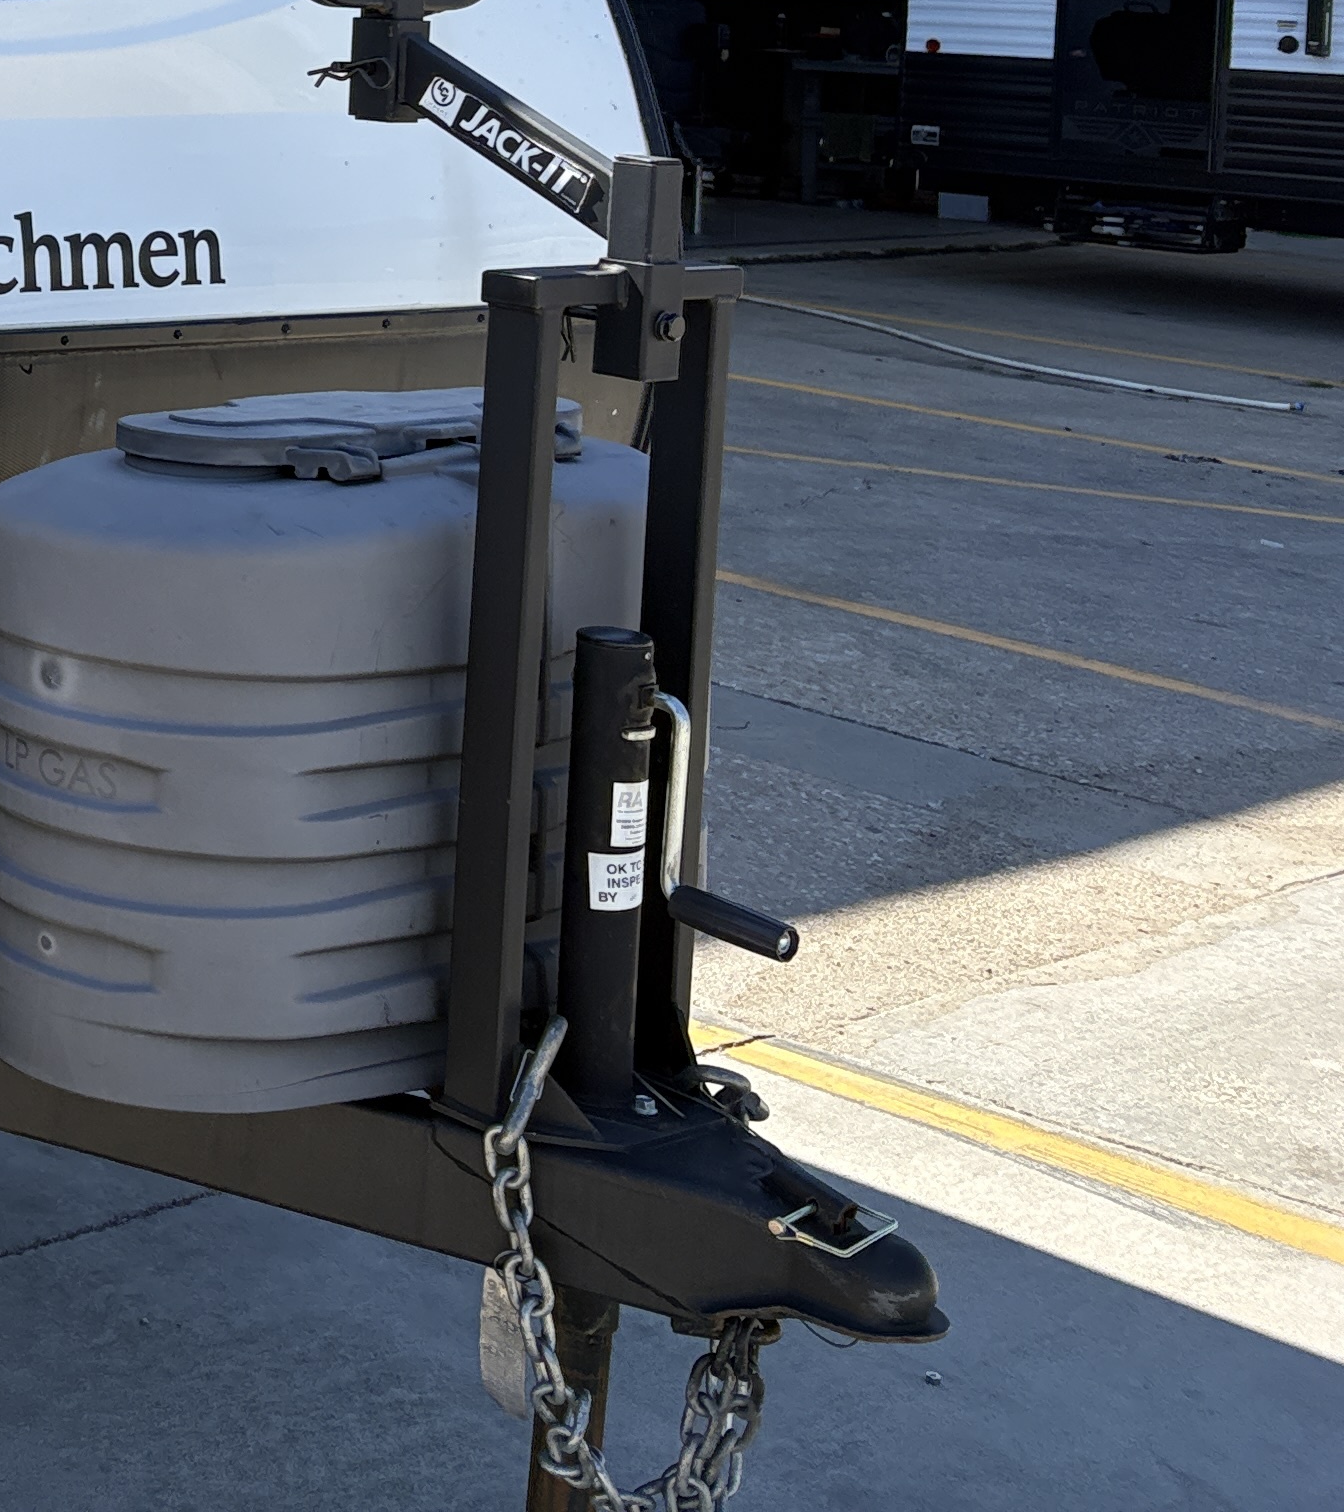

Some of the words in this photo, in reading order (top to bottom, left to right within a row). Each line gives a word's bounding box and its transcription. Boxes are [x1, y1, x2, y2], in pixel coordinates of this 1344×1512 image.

[1074, 99, 1204, 119] PATRIOT
[458, 104, 586, 194] JACK-IT
[5, 733, 30, 771] LP
[38, 748, 118, 800] GAS
[607, 863, 628, 875] OK
[608, 874, 641, 889] INSPE
[598, 891, 618, 903] BY
